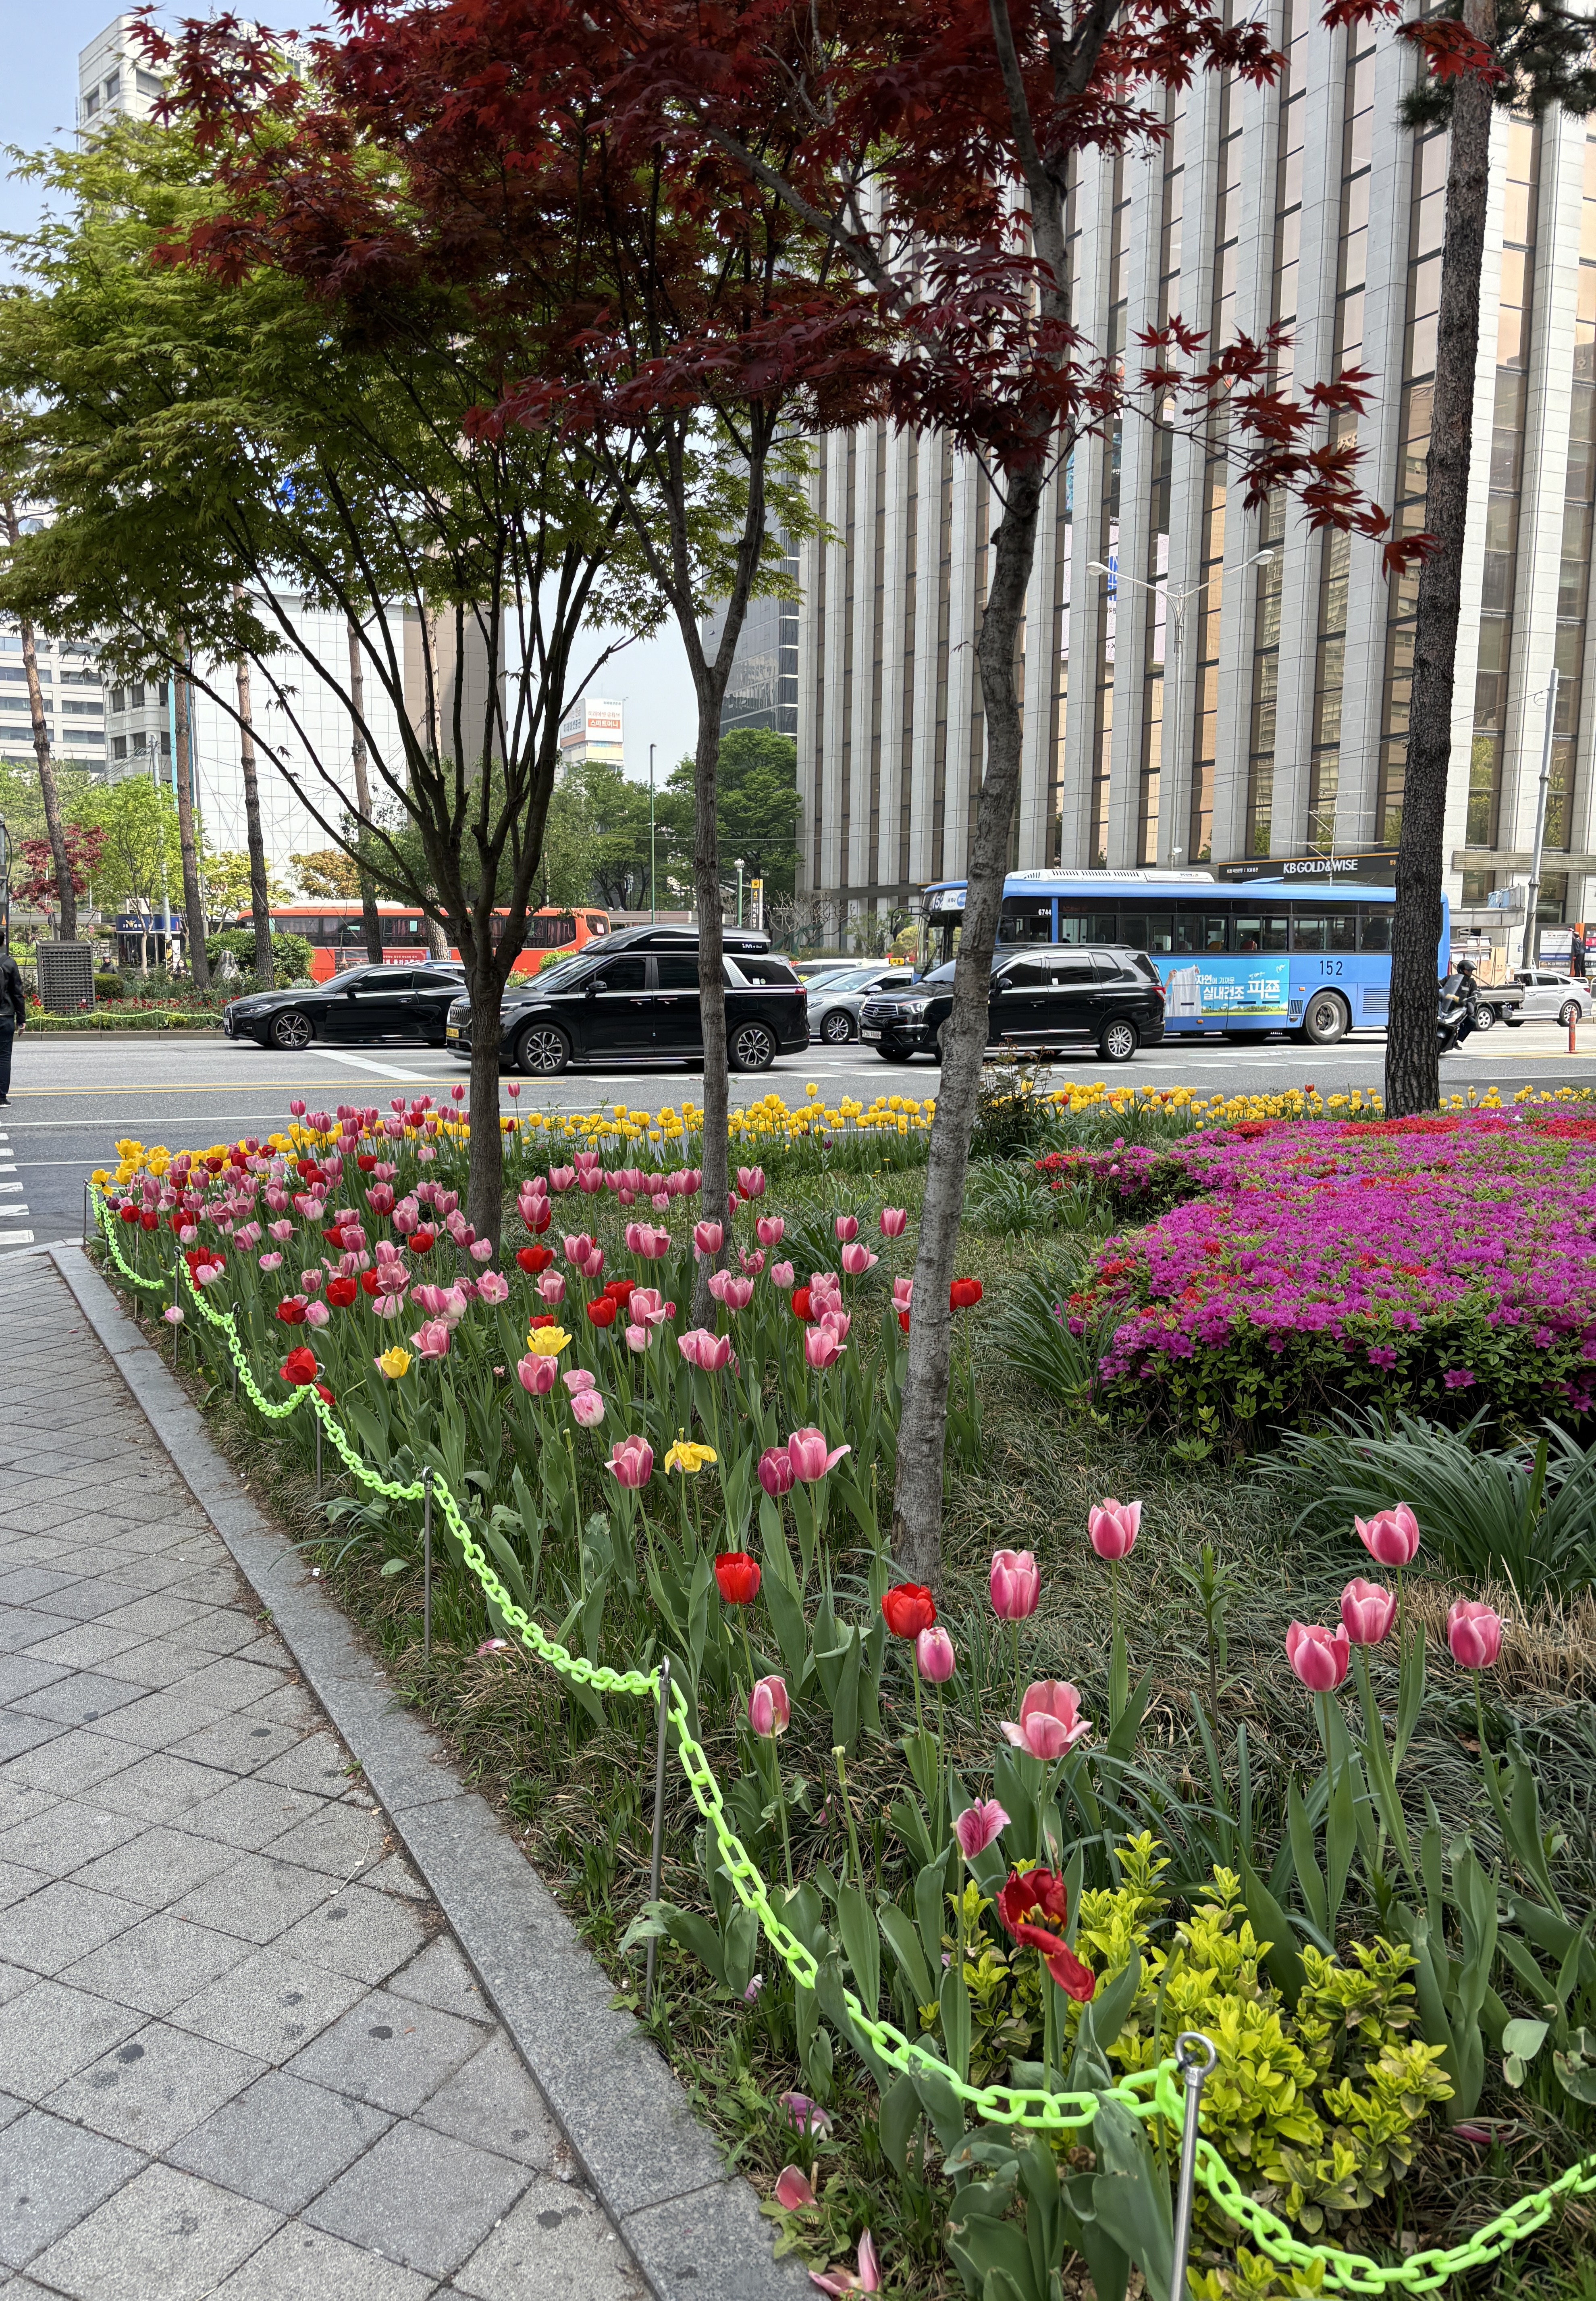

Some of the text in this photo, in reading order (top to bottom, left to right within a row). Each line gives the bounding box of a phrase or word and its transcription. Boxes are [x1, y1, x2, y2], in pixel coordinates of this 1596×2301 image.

[590, 720, 618, 728] 스마트머니
[1320, 960, 1342, 975] 152
[1196, 974, 1217, 984] 자연에
[1203, 986, 1245, 1000] 실내건조
[1247, 979, 1280, 999] 피죤
